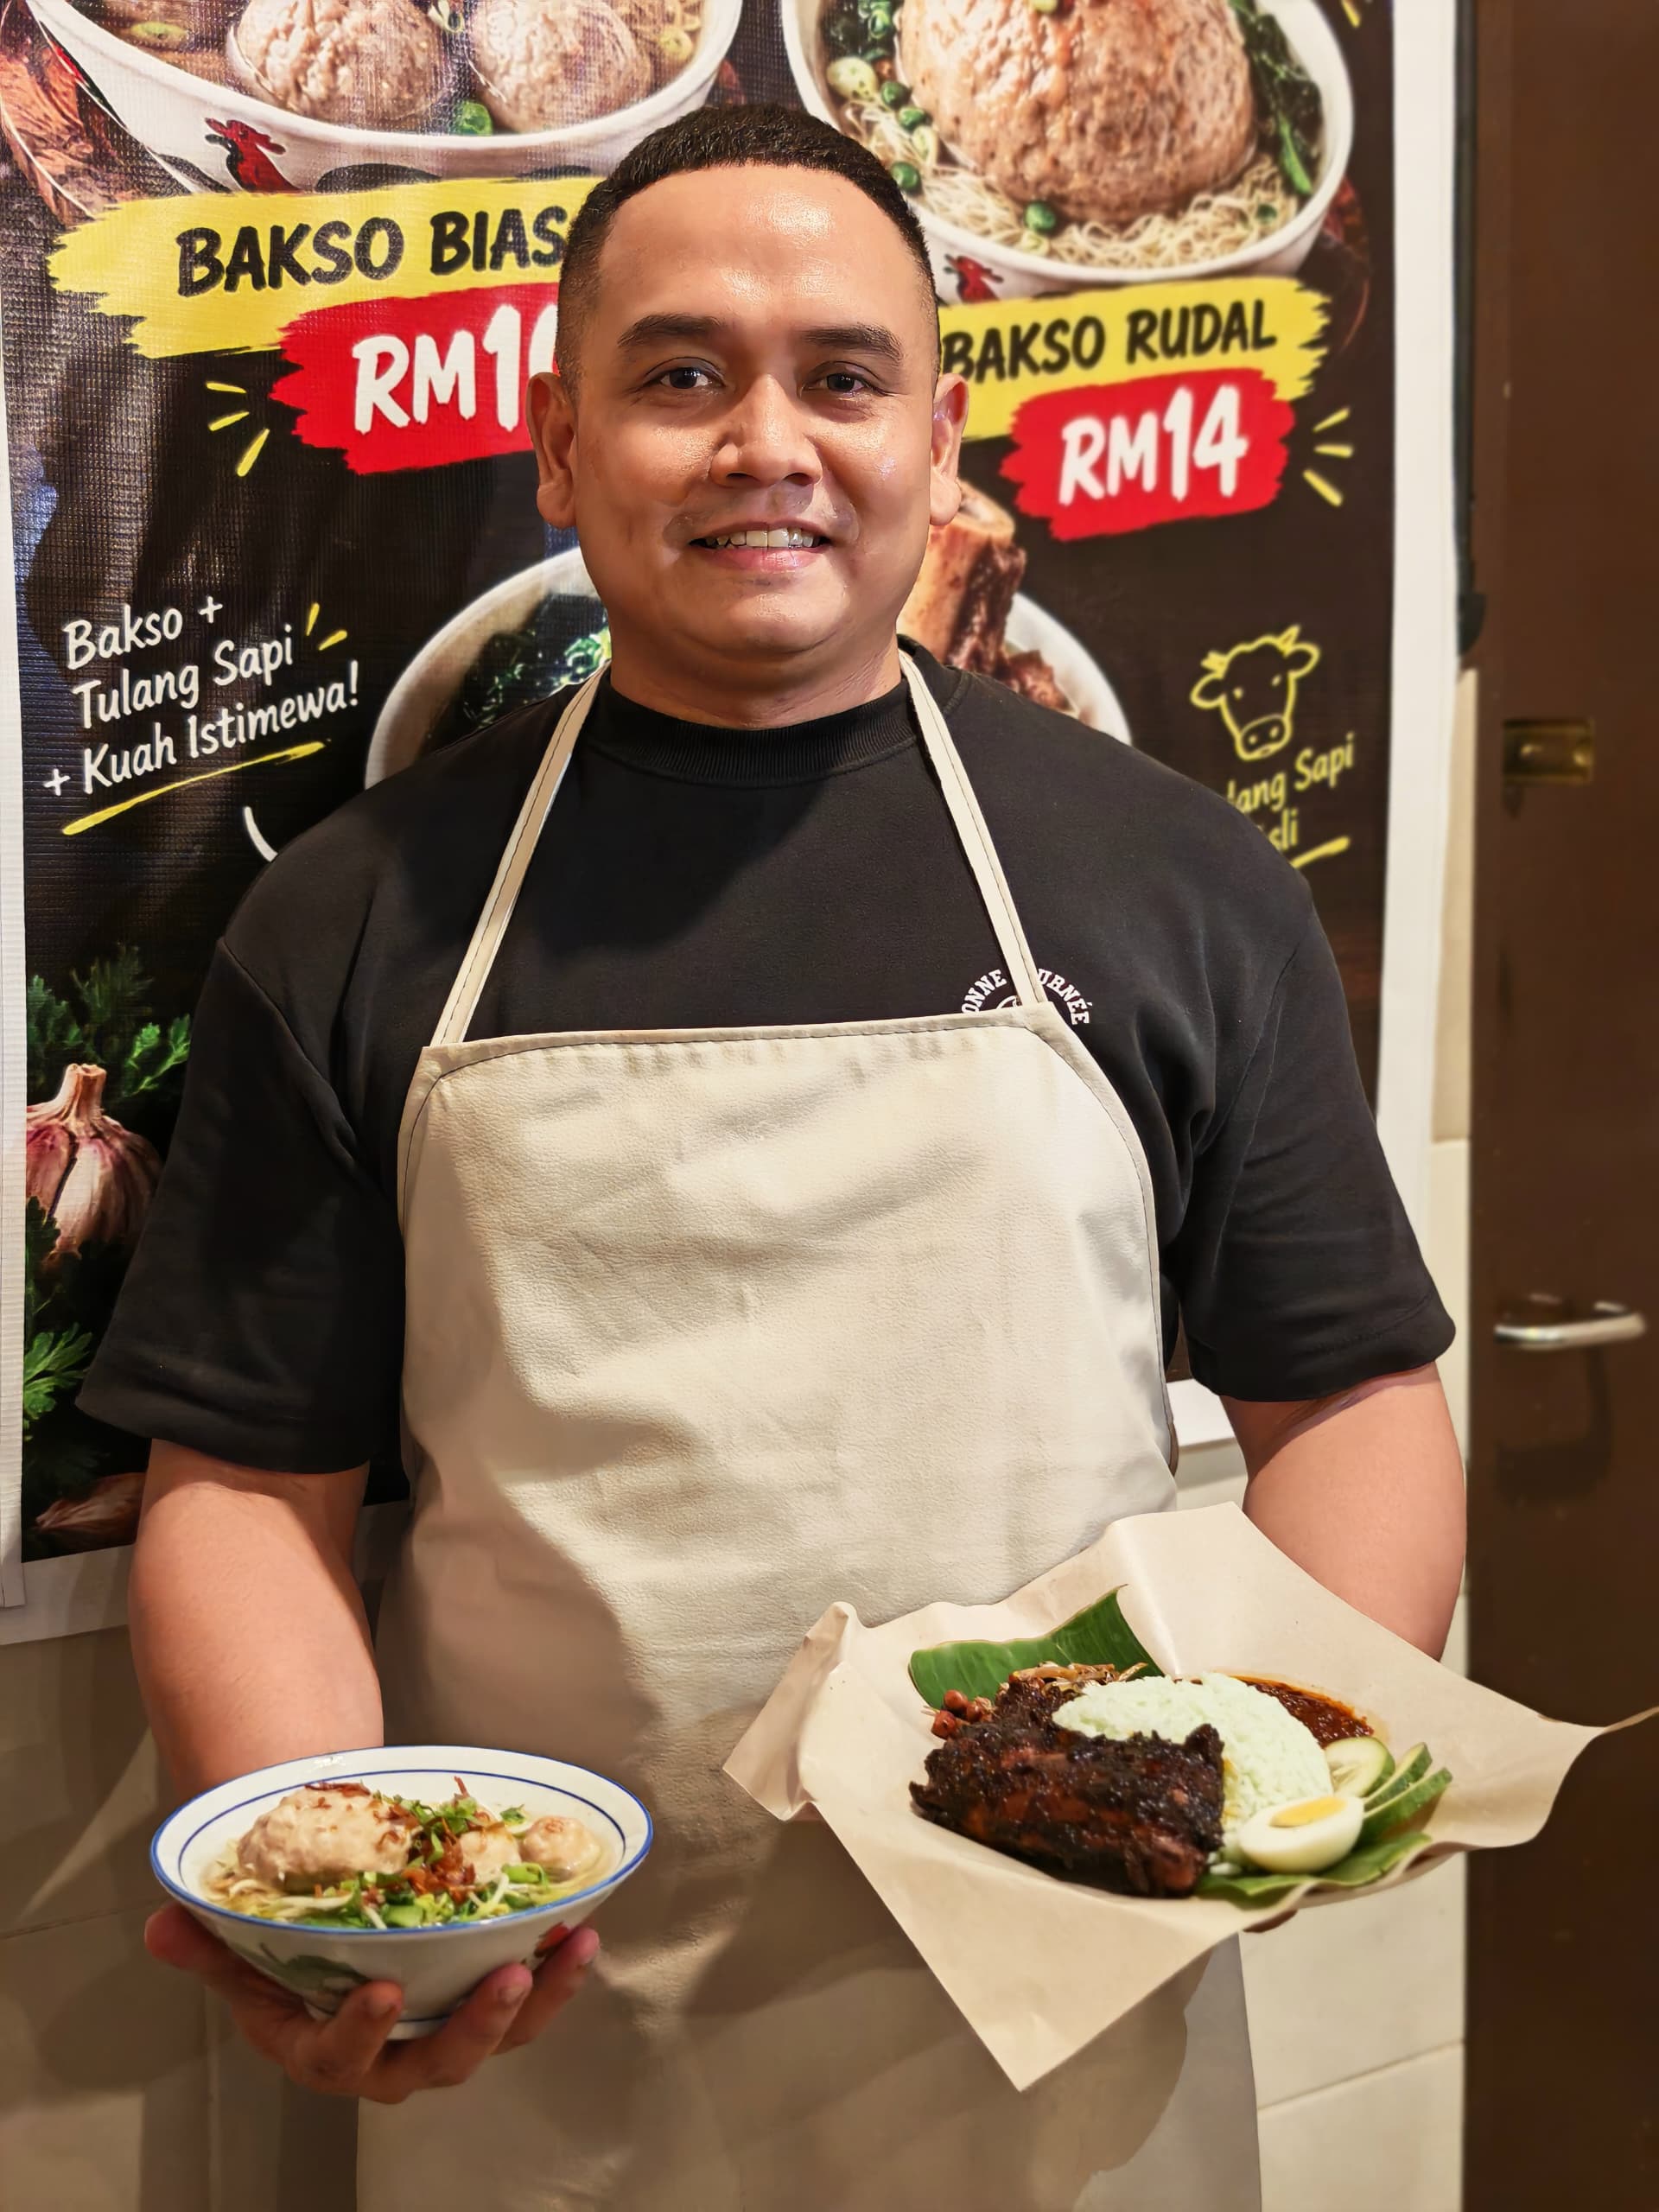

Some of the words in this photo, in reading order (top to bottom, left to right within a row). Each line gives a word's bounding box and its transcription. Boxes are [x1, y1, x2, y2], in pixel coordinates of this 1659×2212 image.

[175, 217, 404, 297] BAKSO
[429, 205, 567, 276] BIAS
[942, 315, 1106, 384] BAKSO
[1126, 299, 1278, 365] RUDAL
[1058, 384, 1249, 506] RM14
[62, 603, 183, 671] Bakso
[198, 595, 223, 624] +
[72, 664, 200, 729] Tulang
[213, 624, 293, 686] Sapi
[42, 768, 71, 796] +
[83, 721, 177, 795] Kuah
[189, 660, 359, 759] Istimewa!
[1227, 772, 1286, 814] lang
[1294, 732, 1354, 789] Sapi
[961, 969, 1007, 1014] ONNE
[1037, 968, 1093, 1025] URNÉE
